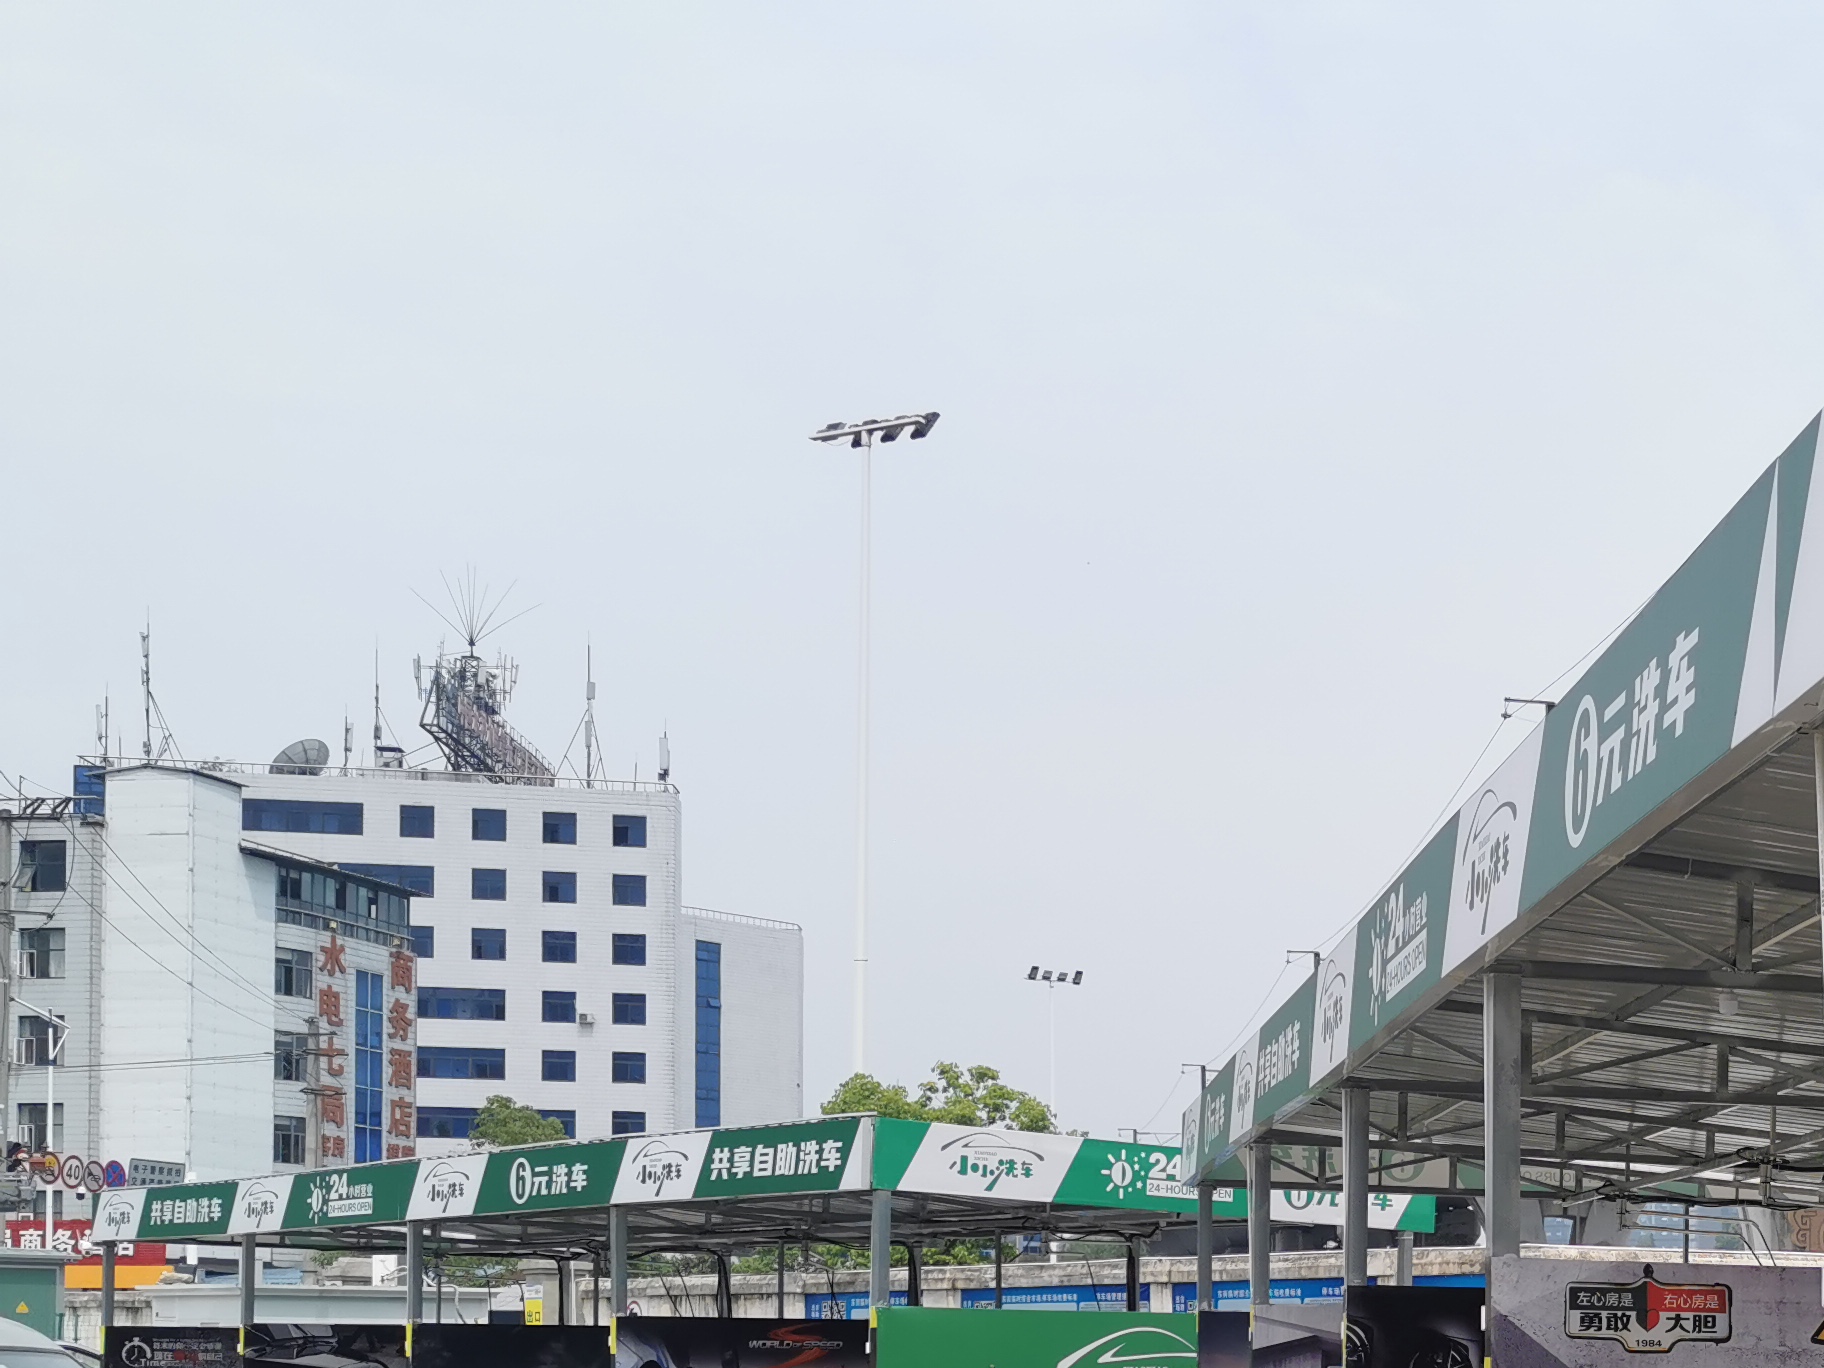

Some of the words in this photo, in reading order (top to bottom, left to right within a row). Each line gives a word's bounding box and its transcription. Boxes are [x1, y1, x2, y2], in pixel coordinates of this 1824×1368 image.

[388, 950, 416, 1139] 商务酒店
[1258, 1020, 1301, 1098] 共享自助洗车
[709, 1138, 844, 1181] 共享自助洗车
[66, 1163, 80, 1181] 40
[1213, 1188, 1232, 1199] PEN
[150, 1197, 223, 1226] 共享自助洗车
[329, 1203, 356, 1215] 24-HOURS
[356, 1201, 372, 1211] OPEN
[1577, 1291, 1634, 1307] 左心房是
[1663, 1293, 1720, 1309] 右心房是
[1578, 1312, 1632, 1332] 勇敢
[1665, 1313, 1718, 1334] 大胆
[748, 1340, 793, 1349] WORLD
[802, 1341, 843, 1350] SPEED
[1635, 1338, 1662, 1348] 1984
